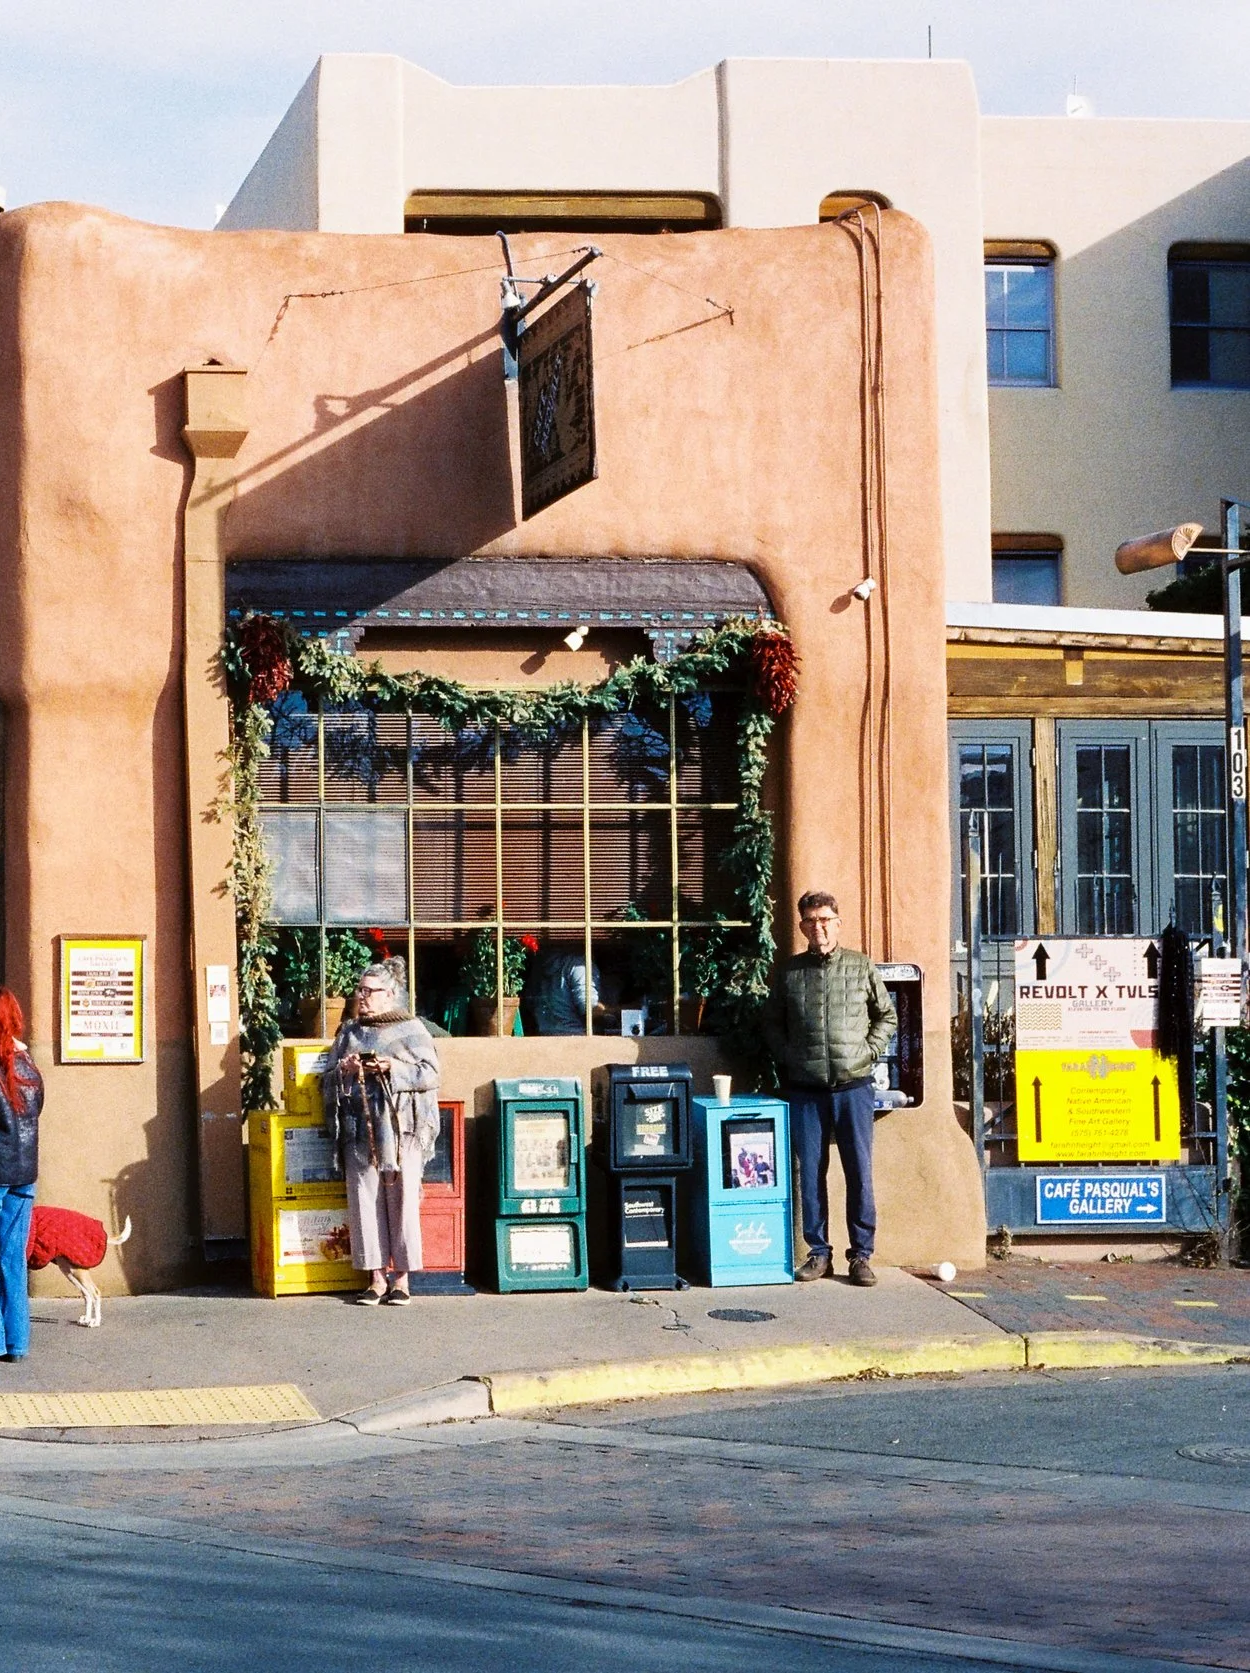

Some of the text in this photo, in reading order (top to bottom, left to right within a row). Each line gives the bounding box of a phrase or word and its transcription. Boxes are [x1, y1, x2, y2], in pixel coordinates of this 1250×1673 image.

[1232, 729, 1244, 797] 103
[1019, 985, 1088, 999] REVOLT
[1096, 985, 1108, 999] X
[631, 1066, 669, 1077] FREE
[1070, 1087, 1127, 1095] Contemporary
[1102, 1118, 1130, 1126] Gallery
[1044, 1180, 1159, 1198] CAFÉ PASQUAL'S
[1069, 1199, 1132, 1214] GALLERY
